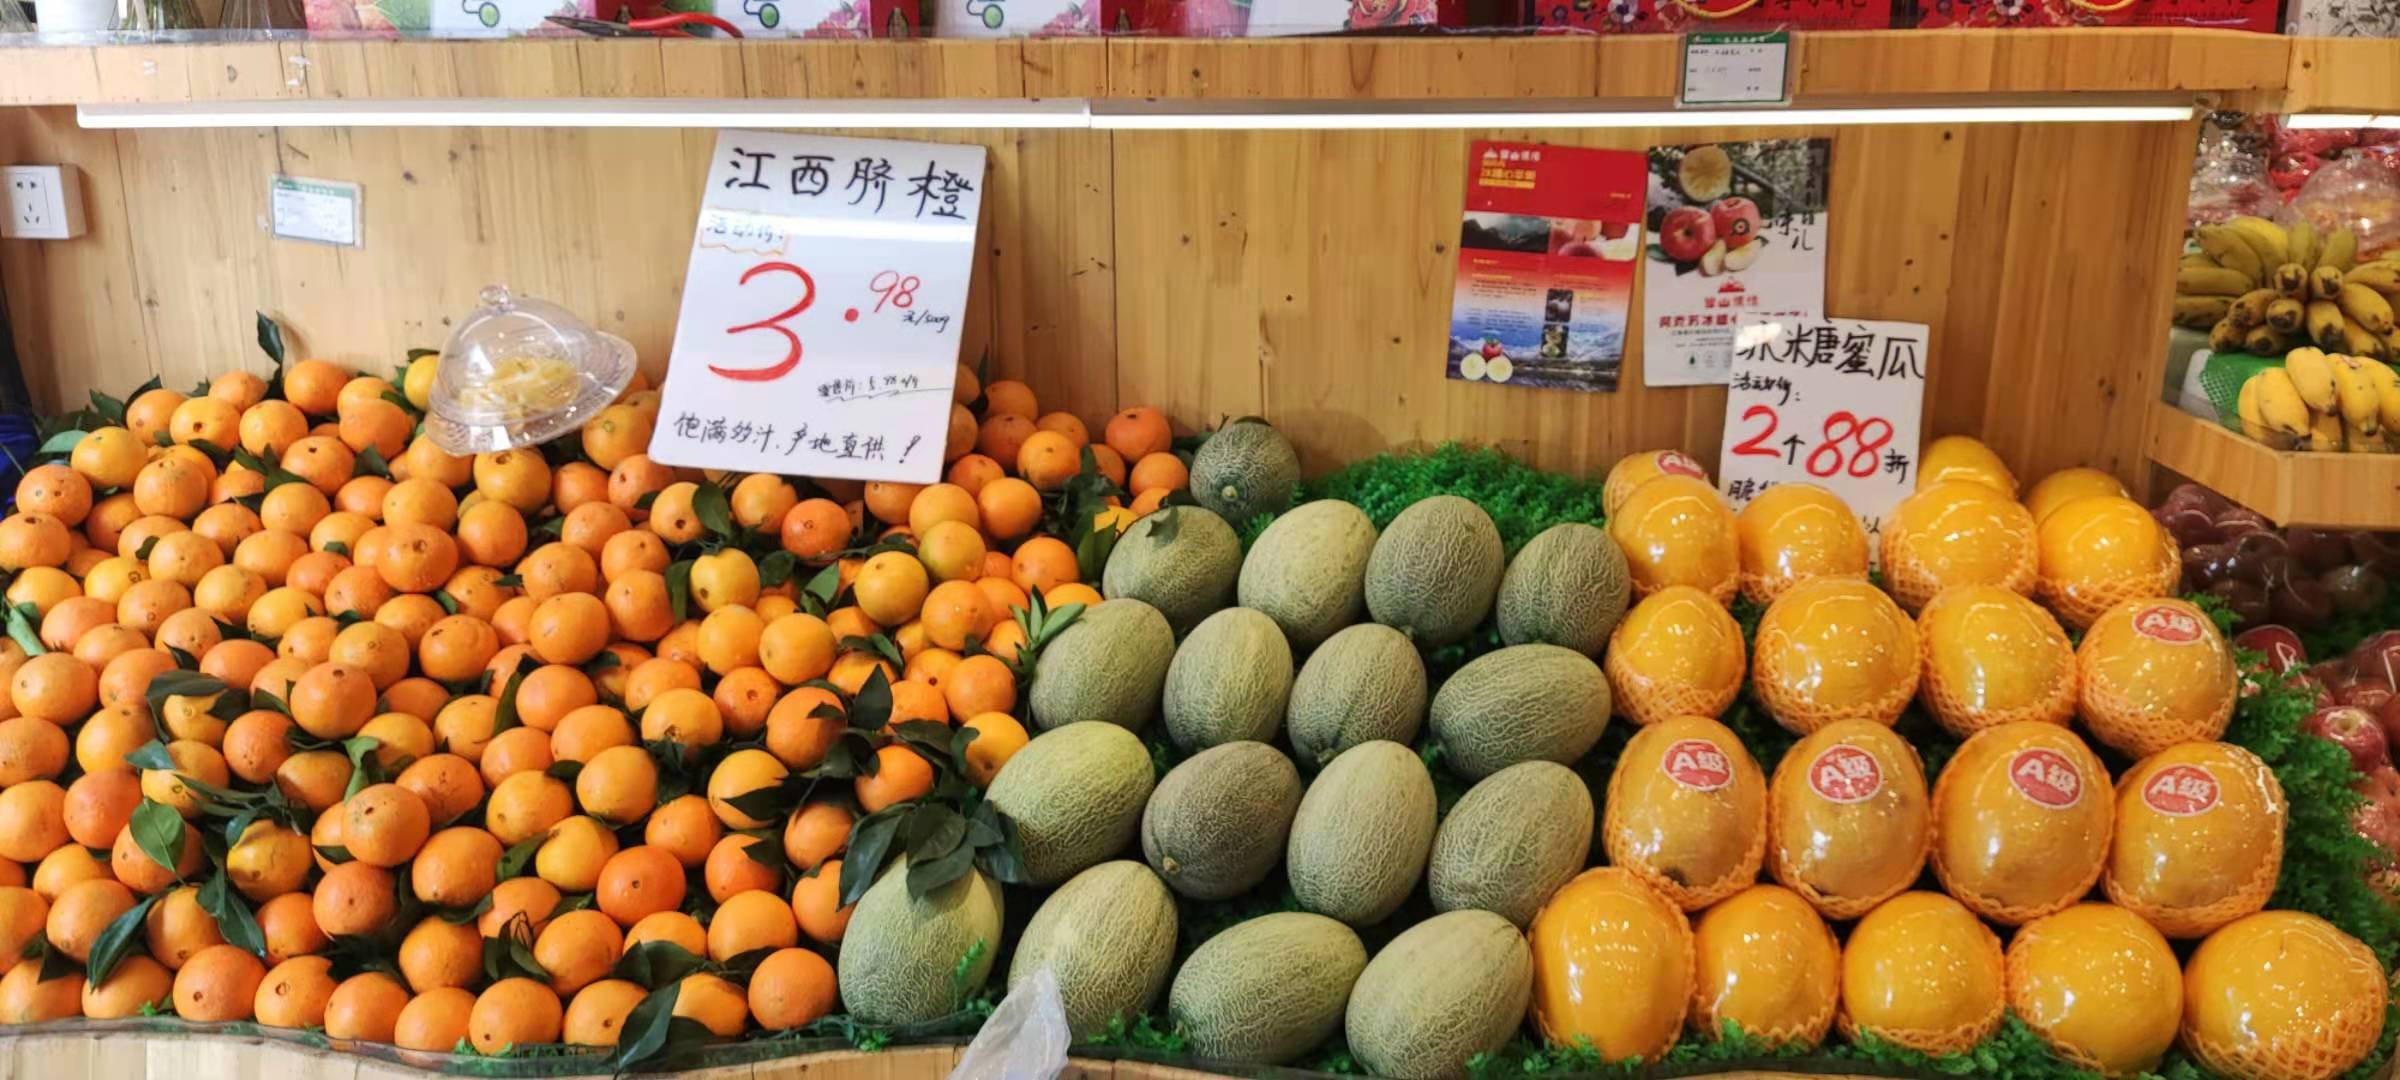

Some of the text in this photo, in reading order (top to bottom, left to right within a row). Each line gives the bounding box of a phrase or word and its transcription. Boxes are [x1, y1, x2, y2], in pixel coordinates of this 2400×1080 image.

[724, 147, 975, 220] 江西脐橙
[2142, 611, 2195, 634] A级
[1671, 750, 1727, 775] A级
[1819, 754, 1876, 791] A级
[2016, 757, 2078, 797] A级
[2149, 775, 2211, 803] A级
